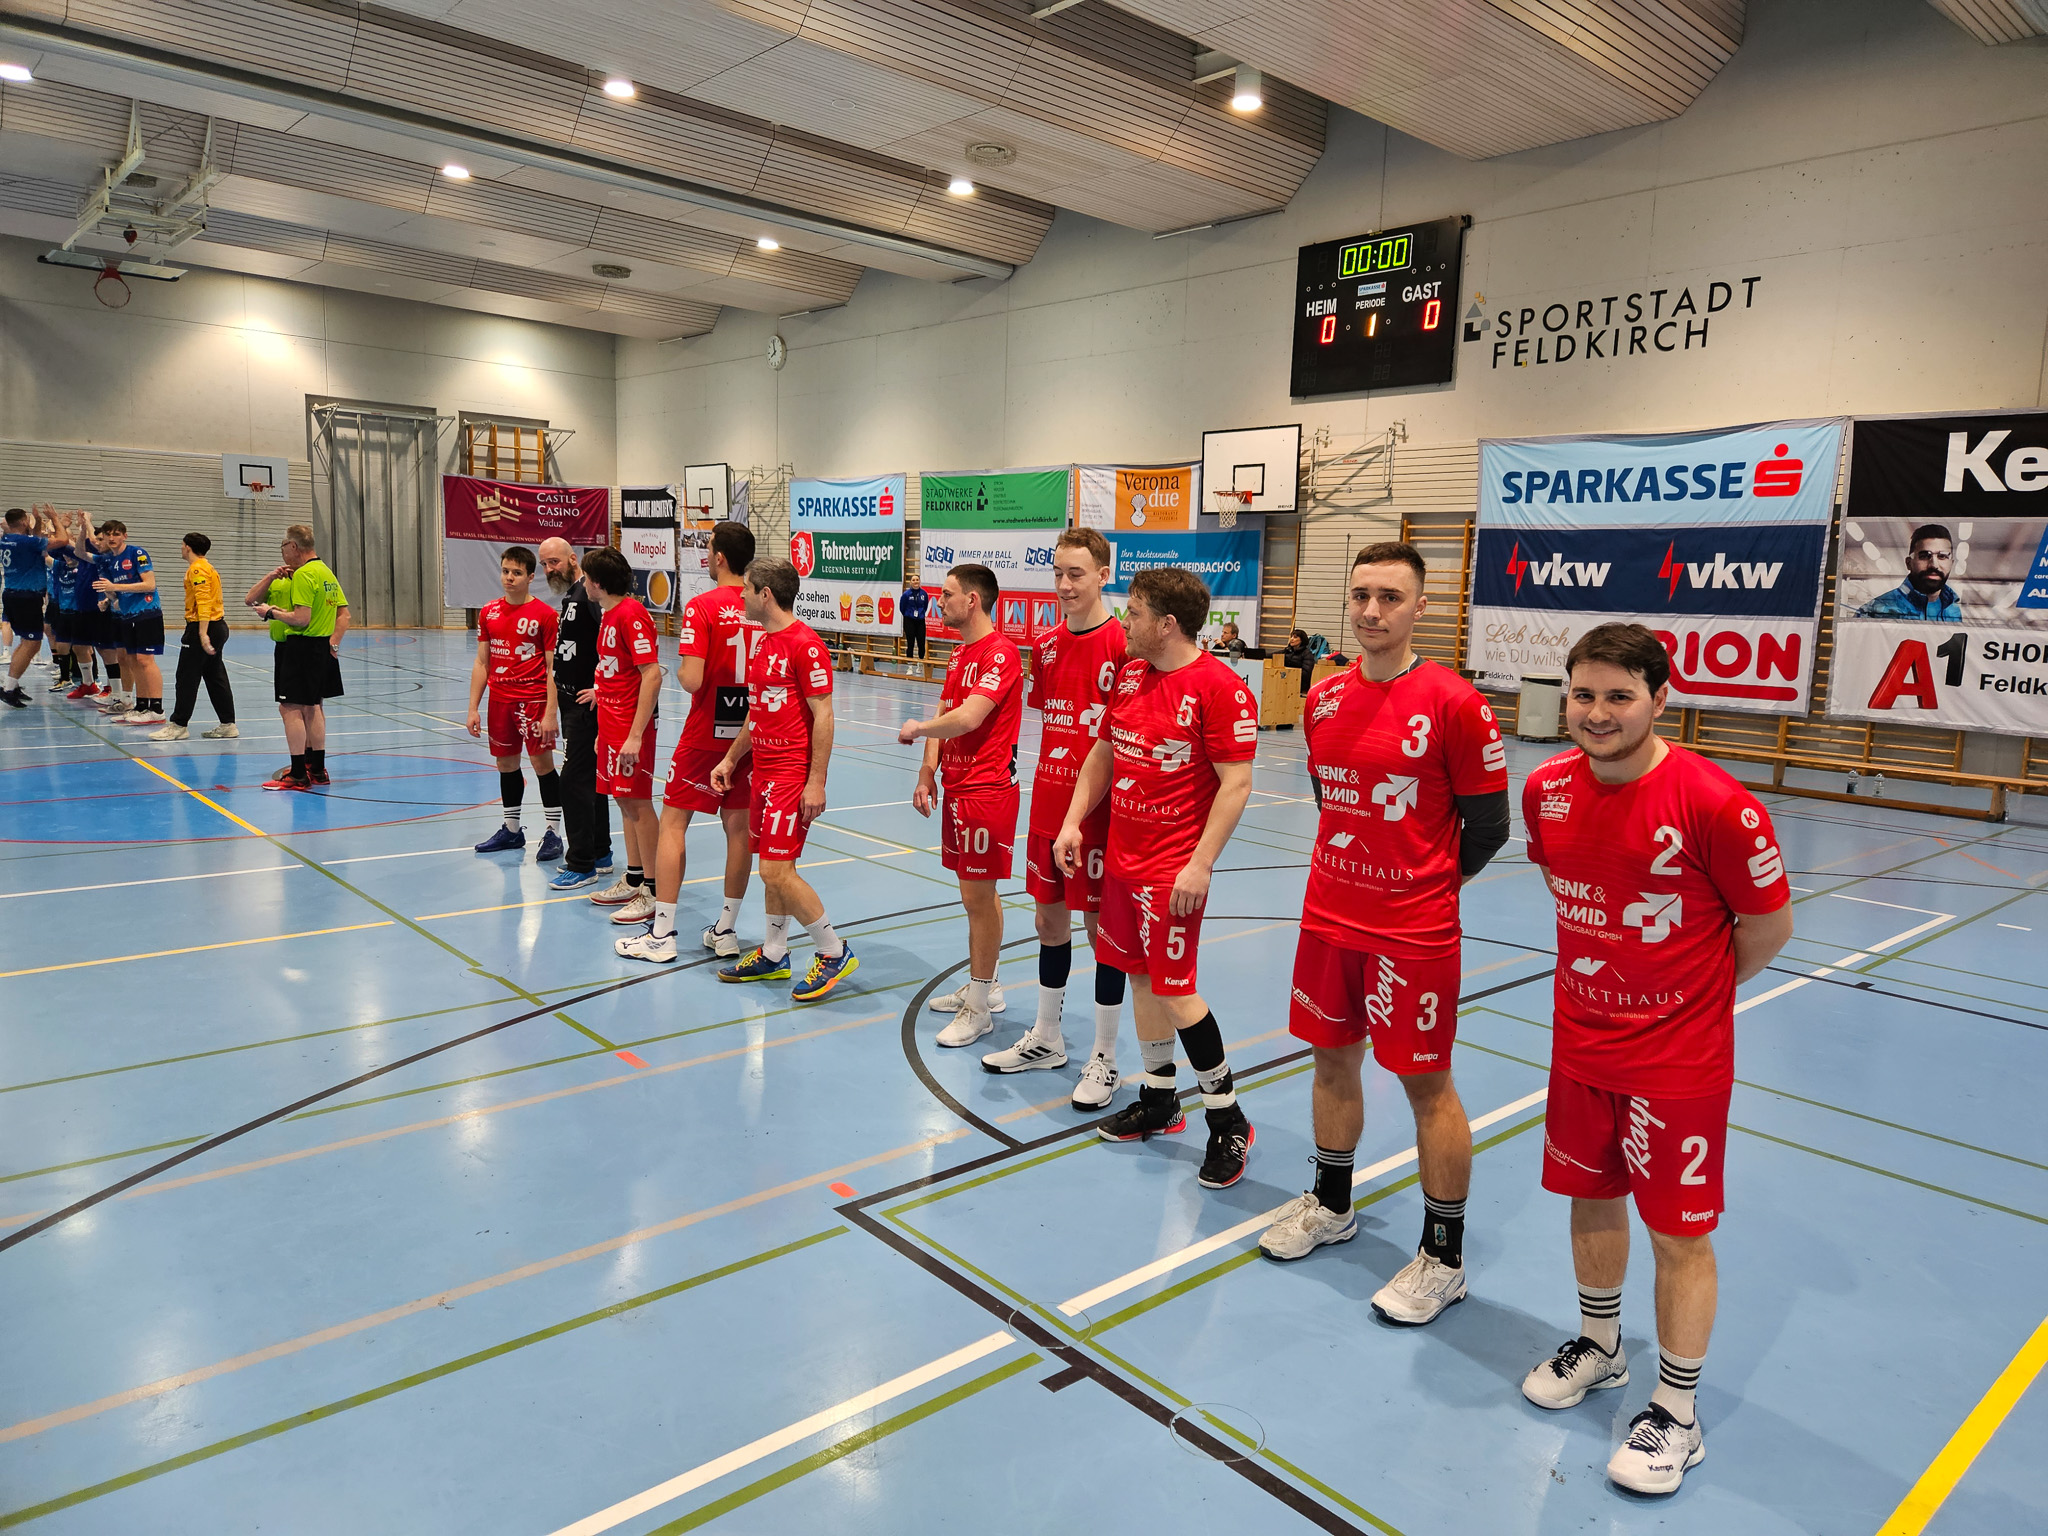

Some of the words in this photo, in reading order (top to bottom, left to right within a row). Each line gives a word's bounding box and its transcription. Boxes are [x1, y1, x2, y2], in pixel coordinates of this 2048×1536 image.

[1342, 238, 1408, 276] 00:00
[1402, 281, 1442, 302] GAST
[1306, 298, 1338, 317] HEIM
[1355, 298, 1386, 310] PERIODE
[1495, 276, 1762, 339] SPORTSTADT
[1367, 312, 1377, 337] 1
[1423, 300, 1441, 330] 0
[1321, 316, 1336, 344] 0
[1492, 318, 1710, 369] FELDKIRCH
[1122, 472, 1180, 490] Verona
[1502, 462, 1746, 504] SPARKASSE
[926, 488, 972, 498] STADTWERKE
[1148, 486, 1180, 508] due
[798, 496, 877, 517] SPARKASSE
[926, 500, 972, 512] FELDKIRCH
[538, 519, 563, 527] Vaduz
[634, 541, 666, 558] Mangold
[821, 540, 894, 565] Fohrenburger
[958, 550, 982, 559] IMMER
[982, 550, 993, 559] AM
[994, 550, 1012, 559] BALL
[1121, 548, 1134, 558] Ihre
[1136, 549, 1179, 559] Rechtsanwälte
[822, 565, 850, 574] LEGENDÄR
[995, 560, 1018, 569] MGT.at
[1120, 561, 1152, 571] KECKEIS
[1225, 560, 1241, 572] OG
[1529, 553, 1612, 588] vkw
[1686, 553, 1784, 590] vkw
[806, 591, 830, 603] sehen
[796, 605, 819, 620] Sieger
[821, 609, 836, 620] aus.
[516, 617, 539, 637] 98
[602, 625, 617, 648] 18
[1486, 623, 1528, 644] Lieb
[1530, 626, 1570, 648] doch
[766, 653, 788, 678] 11
[1485, 648, 1506, 662] wie
[1510, 649, 1530, 664] DU
[961, 662, 978, 688] 10
[1098, 661, 1115, 692] 6
[1484, 670, 1514, 680] Feldkirch
[1868, 632, 1968, 710] A1
[1067, 700, 1074, 711] &
[1177, 694, 1197, 727] 5
[531, 721, 542, 738] 9
[1402, 714, 1431, 758] 3
[1349, 770, 1360, 784] &
[770, 810, 798, 836] 11
[1352, 808, 1371, 818] GMBH
[961, 827, 989, 854] 10
[1651, 825, 1683, 876] 2
[1087, 849, 1104, 879] 6
[1593, 886, 1606, 904] &
[1556, 897, 1607, 926] CHMID
[1166, 926, 1186, 960] 5
[1598, 931, 1622, 941] GMBH
[1165, 977, 1189, 987] Kempa
[1417, 992, 1439, 1031] 3
[1413, 1053, 1438, 1062] Kempa
[1680, 1136, 1708, 1186] 2
[1682, 1209, 1714, 1222] Kempa
[1647, 1463, 1674, 1472] Kempa
